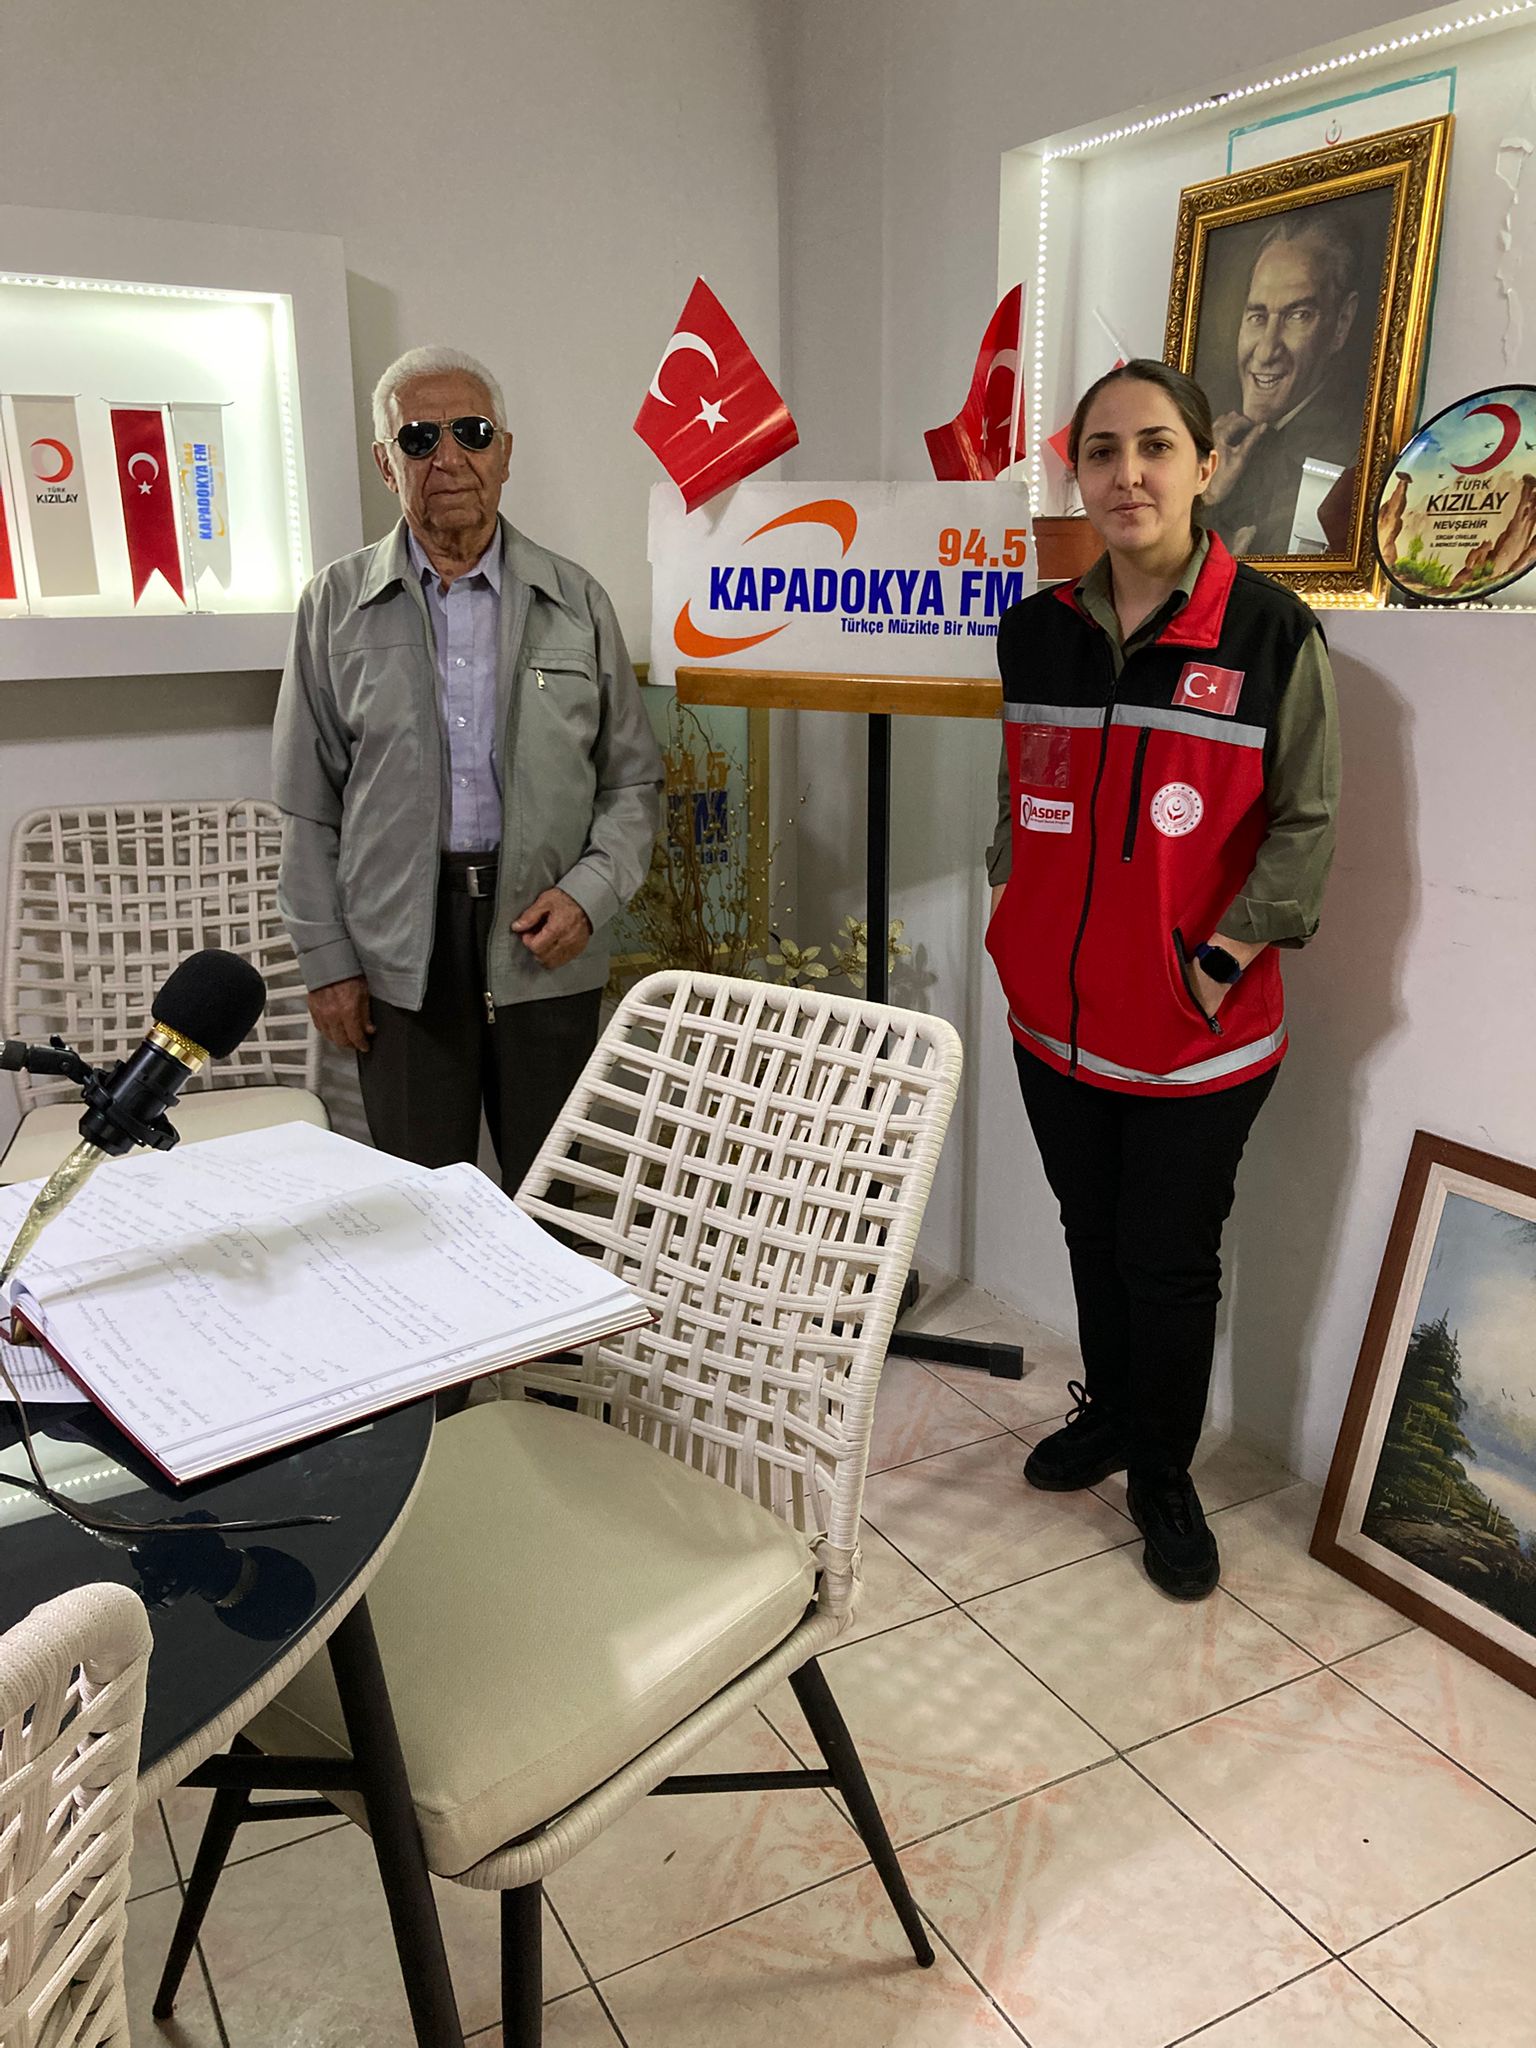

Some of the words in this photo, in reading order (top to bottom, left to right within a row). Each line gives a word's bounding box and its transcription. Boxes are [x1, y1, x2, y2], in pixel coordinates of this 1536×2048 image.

[193, 443, 207, 461] FM
[36, 494, 78, 503] KIZILAY
[195, 465, 212, 539] KAPADOKYA
[1426, 491, 1510, 512] KIZILAY
[1433, 517, 1488, 531] NEVŞEHİR
[938, 528, 1027, 567] 94.5
[709, 566, 944, 616] KAPADOKYA
[960, 570, 1024, 617] FM
[841, 617, 884, 635] Türkçe
[888, 618, 940, 635] Müzikte
[944, 620, 963, 636] Bir
[966, 621, 998, 637] Num
[1030, 806, 1071, 820] ASDEP
